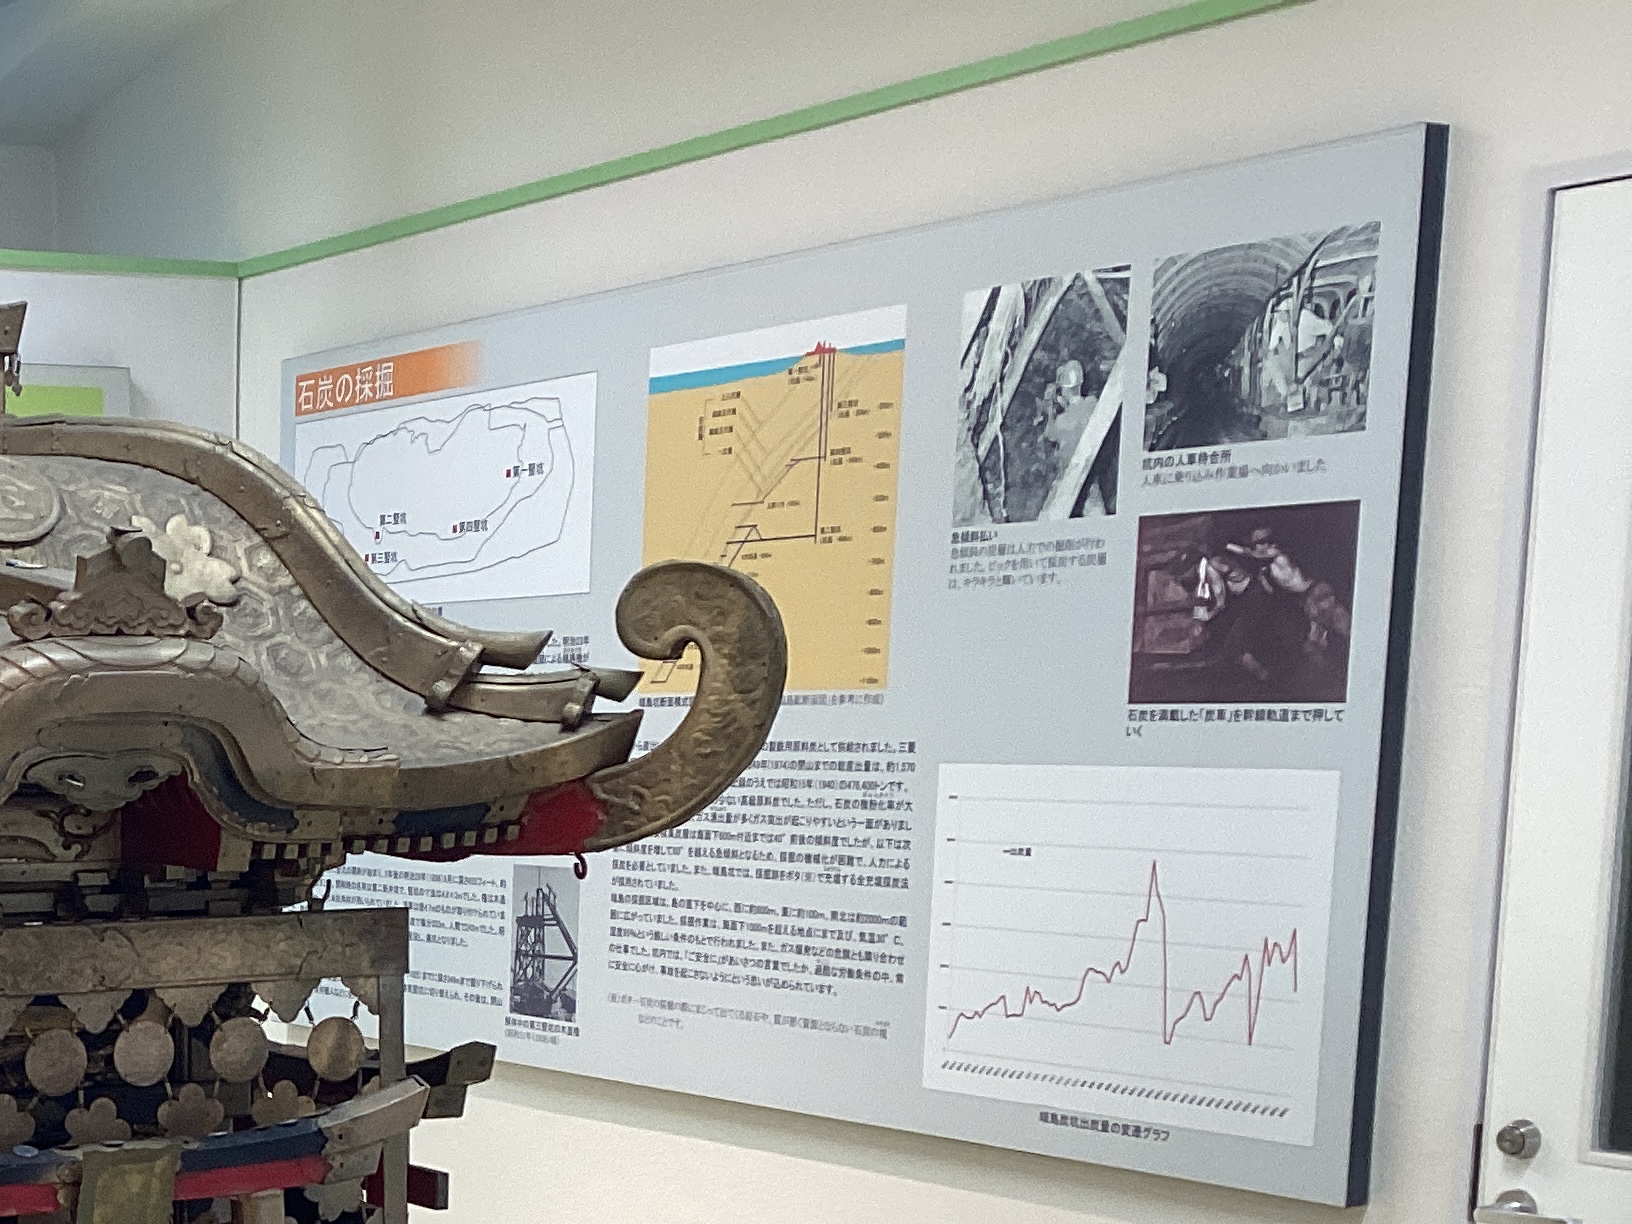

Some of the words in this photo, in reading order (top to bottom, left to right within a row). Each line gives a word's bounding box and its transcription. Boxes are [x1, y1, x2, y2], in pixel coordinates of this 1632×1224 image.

[297, 359, 394, 415] 石炭の採掘
